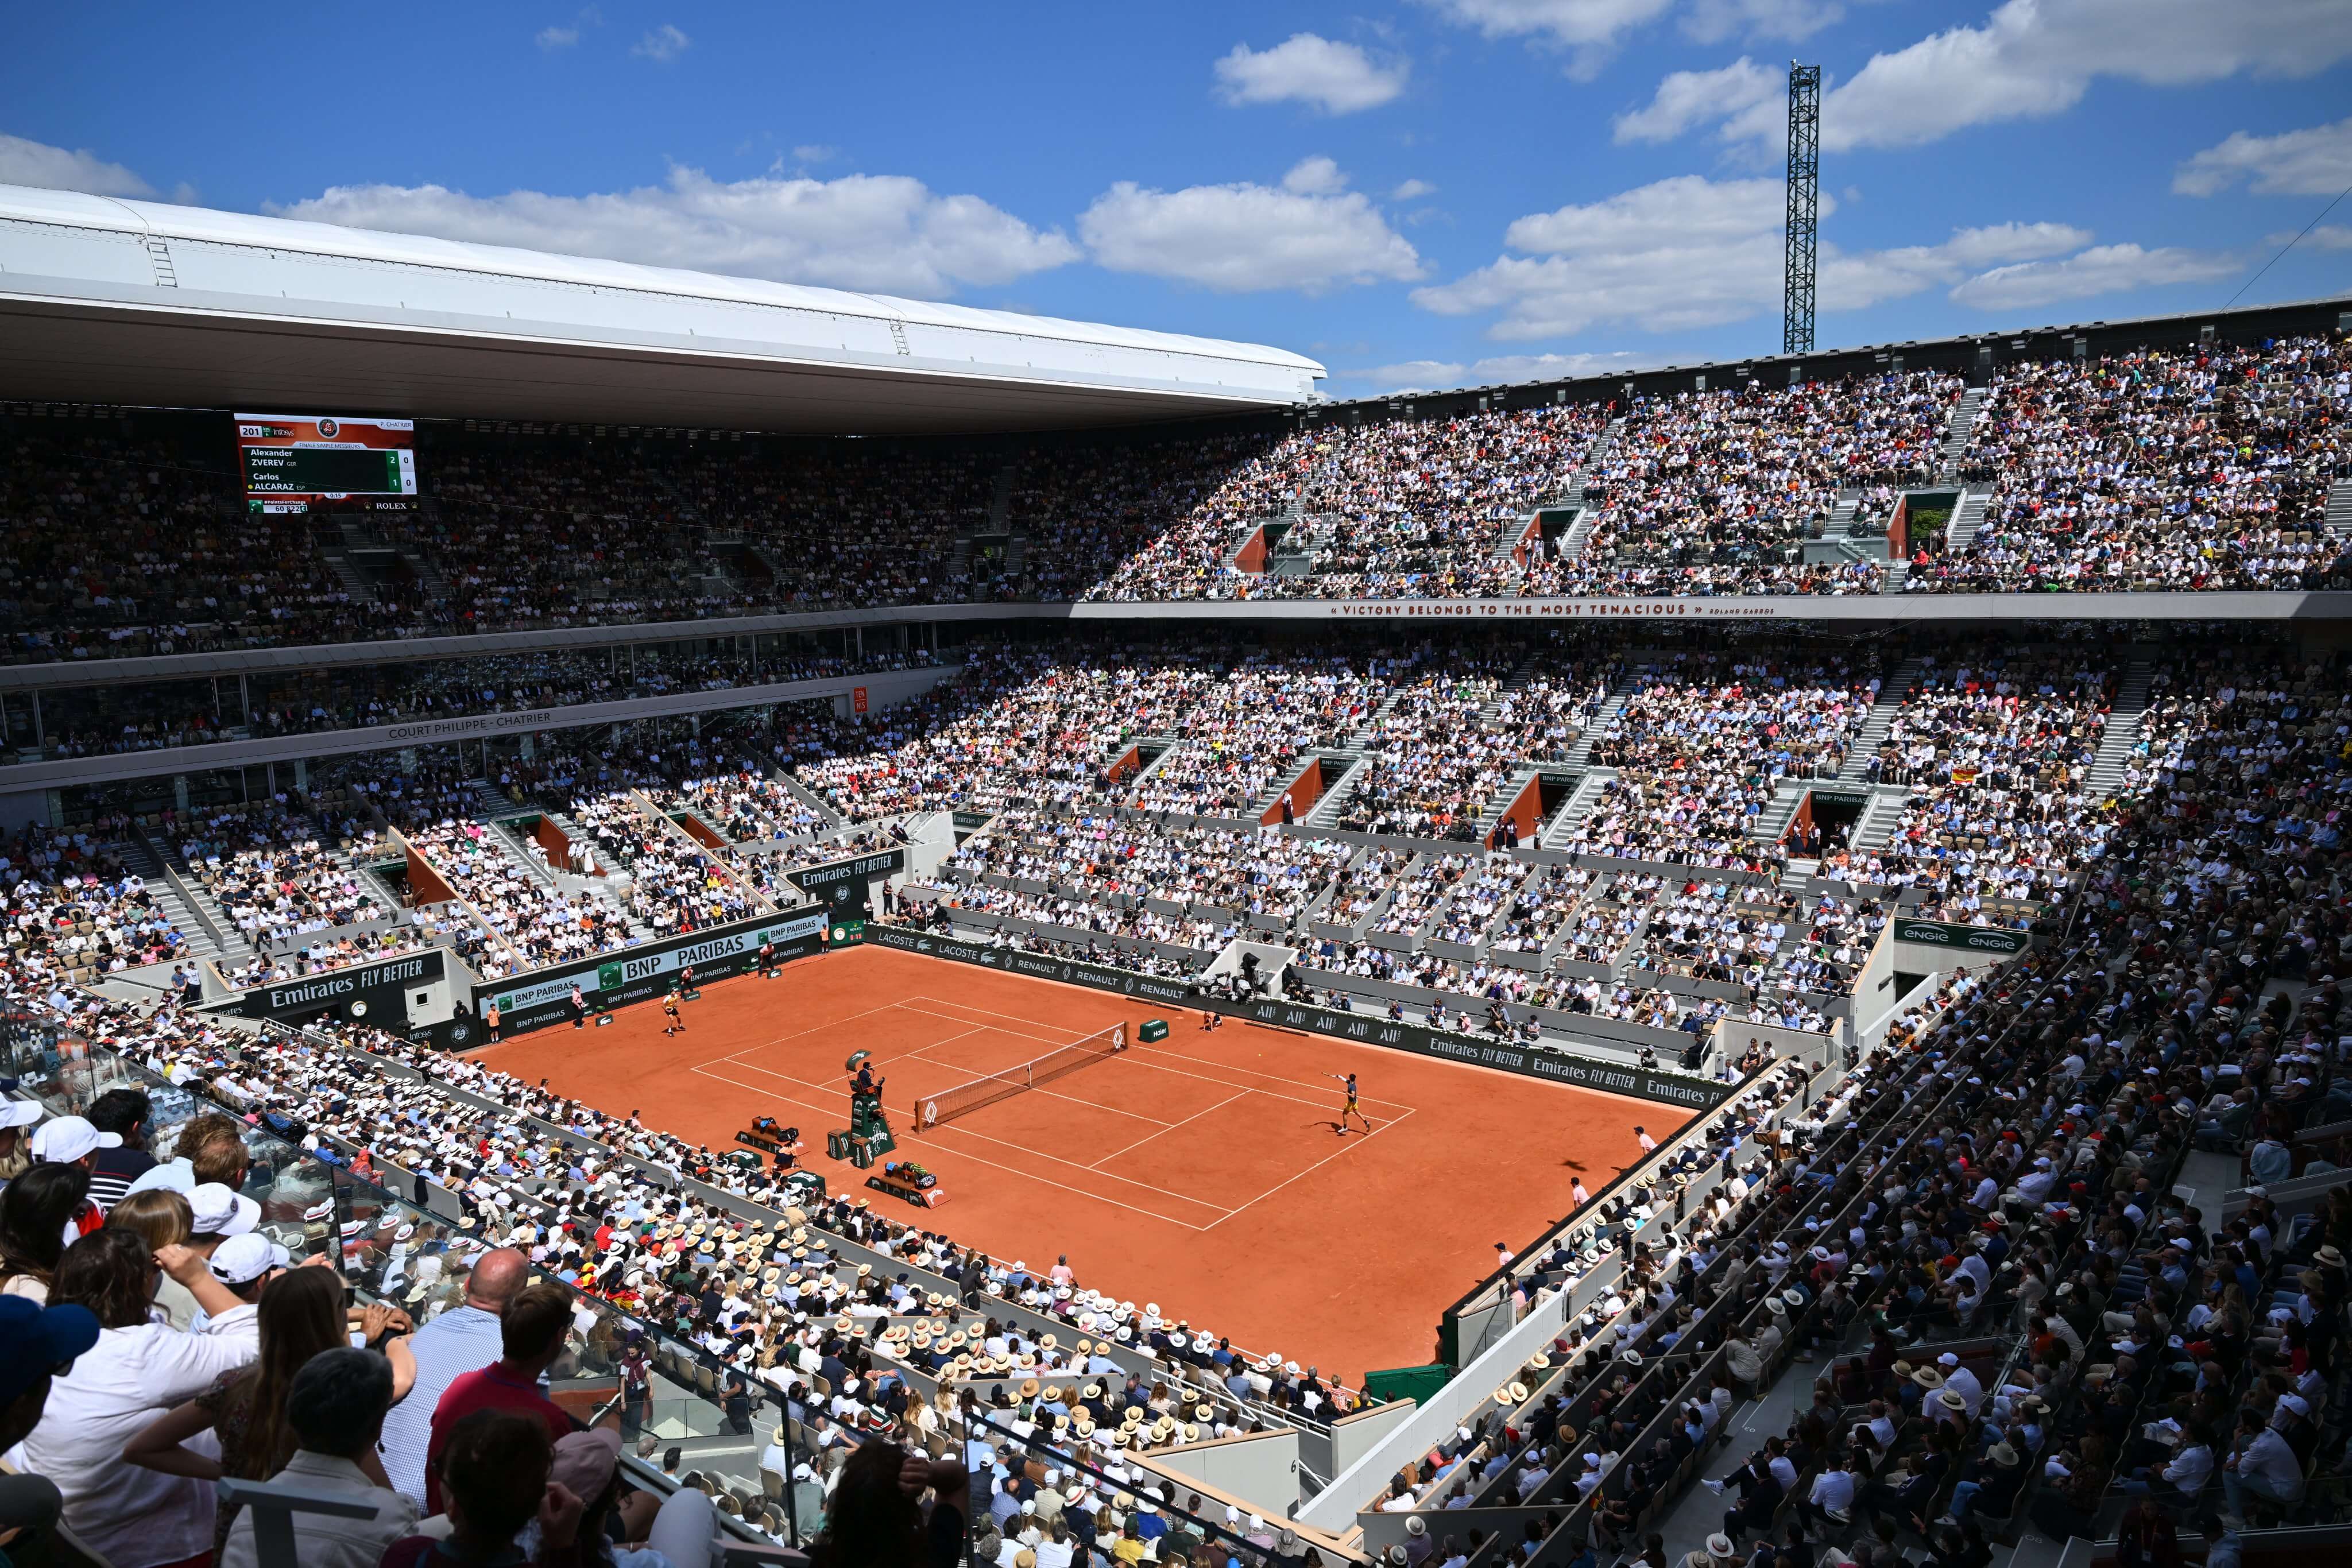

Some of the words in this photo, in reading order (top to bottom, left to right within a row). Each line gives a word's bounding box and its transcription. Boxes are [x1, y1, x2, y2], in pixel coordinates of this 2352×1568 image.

[273, 428, 294, 436] Infosys
[1343, 605, 1401, 615] VICTORY
[1409, 605, 1472, 615] BELONGS
[1480, 605, 1497, 615] TO
[1505, 605, 1532, 615] THE
[1541, 605, 1582, 615] MOST
[1589, 605, 1685, 615] TENACIOUS
[856, 690, 865, 699] TEN
[856, 702, 865, 710] NIS
[389, 725, 431, 738] COURT
[435, 719, 486, 734] PHILIPPE
[497, 713, 551, 726] CHATRIER
[954, 815, 976, 824] Emirates
[802, 866, 851, 886] Emirates
[856, 861, 868, 875] FLY
[868, 855, 892, 872] BETTER
[771, 928, 786, 938] BNP
[787, 920, 816, 934] PARIBAS
[879, 932, 915, 947] LACOSTE
[626, 957, 661, 979] BNP
[678, 935, 744, 966] PARIBAS
[780, 946, 804, 958] PARIBAS
[939, 944, 977, 960] LACOSTE
[690, 973, 703, 982] BNP
[705, 966, 731, 978] PARIBAS
[1018, 959, 1057, 974] RENAULT
[271, 976, 354, 1007] Emirates
[361, 969, 380, 988] FLY
[384, 959, 423, 982] BETTER
[1077, 971, 1118, 986] RENAULT
[515, 991, 535, 1003] BNP
[536, 981, 574, 998] PARIBAS
[608, 994, 622, 1004] BNP
[624, 986, 652, 1000] PARIBAS
[1140, 984, 1184, 1000] RENAULT
[216, 1006, 243, 1016] irates
[517, 1019, 532, 1028] BNP
[534, 1009, 566, 1024] PARIBAS
[409, 1029, 432, 1041] Infosys
[1153, 1027, 1166, 1037] Haier
[1430, 1037, 1478, 1058] Emirates
[1481, 1048, 1494, 1062] FLY
[1494, 1050, 1524, 1067] BETTER
[1534, 1058, 1586, 1080] Emirates
[1590, 1069, 1604, 1083] FLY
[1605, 1071, 1635, 1089] BETTER
[1647, 1079, 1705, 1102] Emirates
[1291, 1459, 1297, 1473] 6
